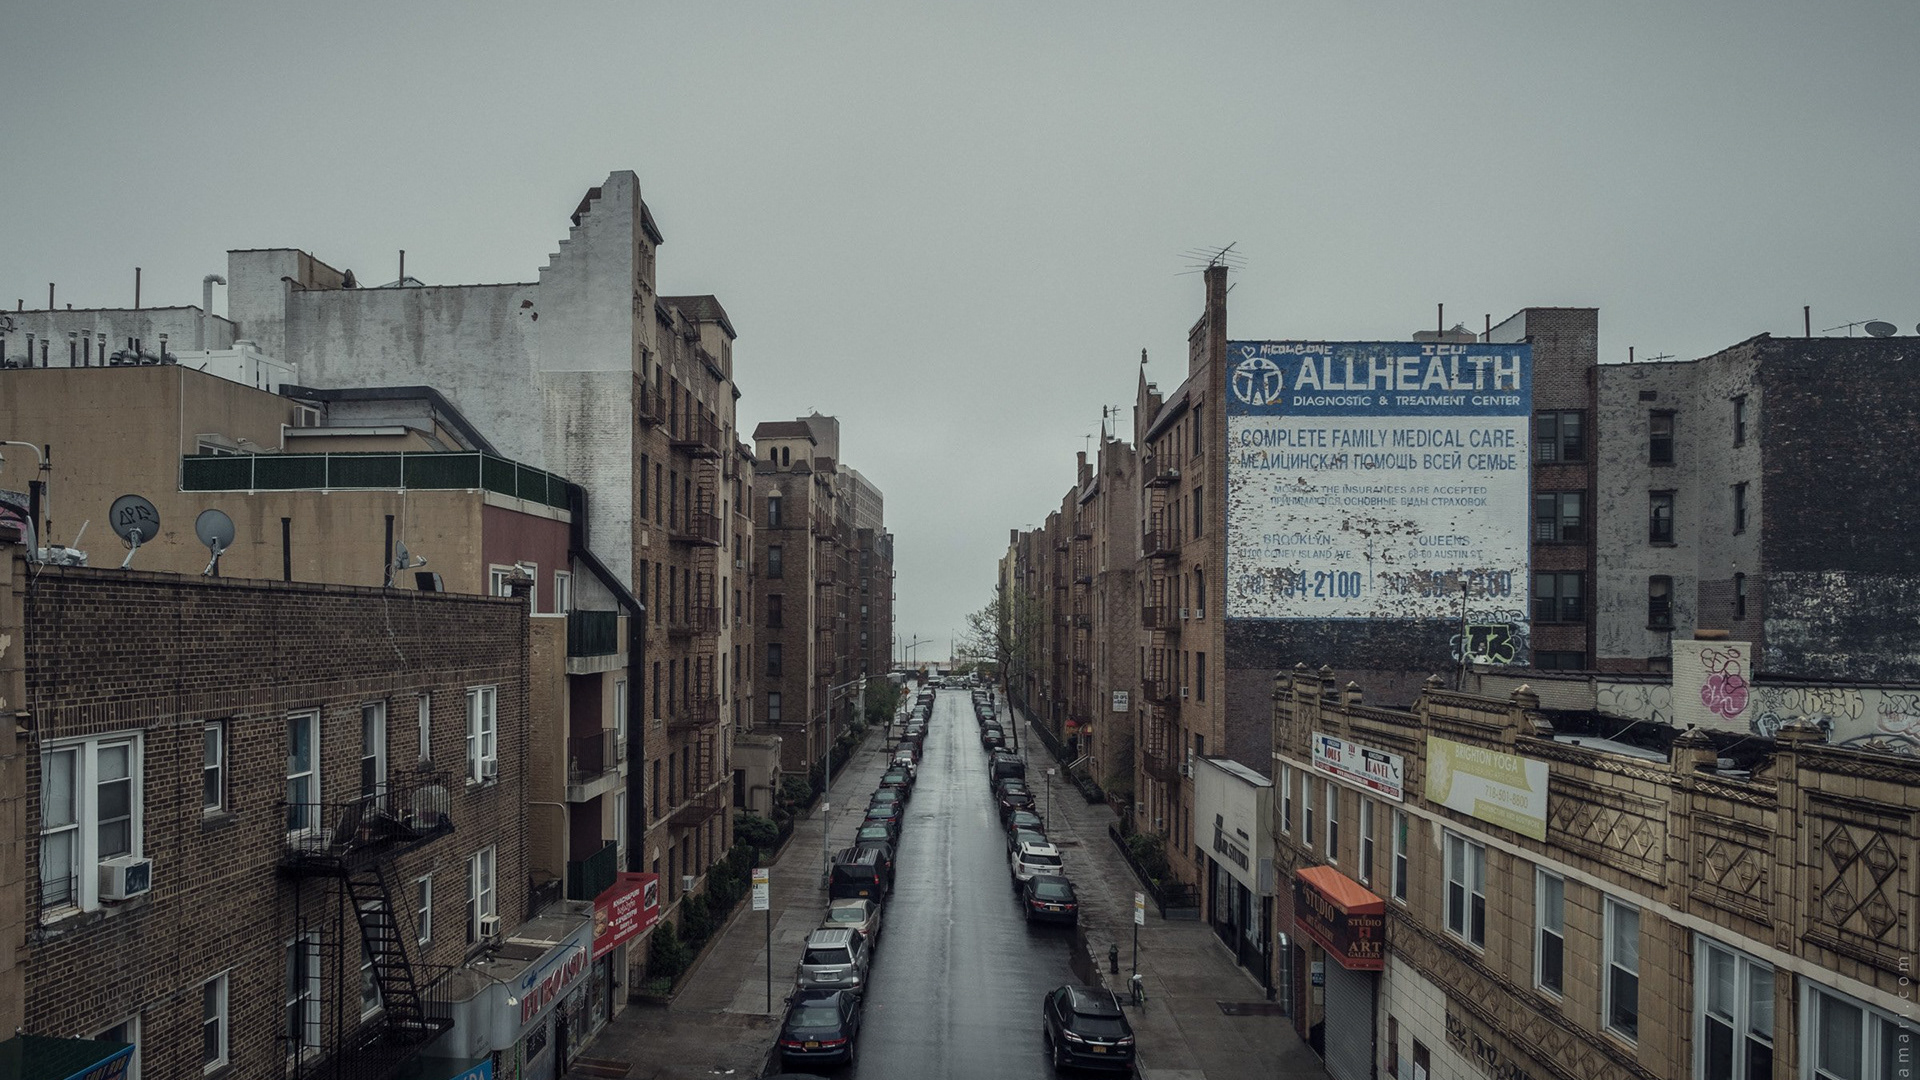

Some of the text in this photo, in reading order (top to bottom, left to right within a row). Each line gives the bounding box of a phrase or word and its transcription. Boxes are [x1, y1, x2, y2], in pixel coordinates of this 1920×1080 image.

[1294, 355, 1521, 391] ALLHEALTH
[1293, 396, 1520, 406] DIAGNOSTIC & TREATMENT CENTER
[1240, 429, 1515, 448] COMPLETE FAMILY MEDICAL CARE
[1240, 450, 1517, 471] МЕДИЦИНСКАЯ ПОМОЩЬ ВСЕЙ СЕМЬЕ
[1320, 485, 1340, 494] THE
[1342, 485, 1407, 495] INSURANCES
[1410, 486, 1430, 495] ARE
[1433, 486, 1488, 495] ACCEPTED
[1344, 496, 1397, 506] ОСНОВНЫЕ
[1431, 497, 1488, 507] СТРАХОВОК
[1263, 533, 1331, 545] BROOKLYN
[1419, 535, 1471, 546] QUEENS
[1264, 549, 1297, 558] CONEY
[1299, 549, 1332, 559] ISLAND
[1434, 550, 1469, 559] AUSTIN
[1455, 744, 1490, 767] BRIGHTON
[1492, 753, 1518, 773] YOGA
[1306, 888, 1335, 922] STUDIO
[1348, 918, 1382, 927] STUDIO
[1349, 941, 1382, 952] ART
